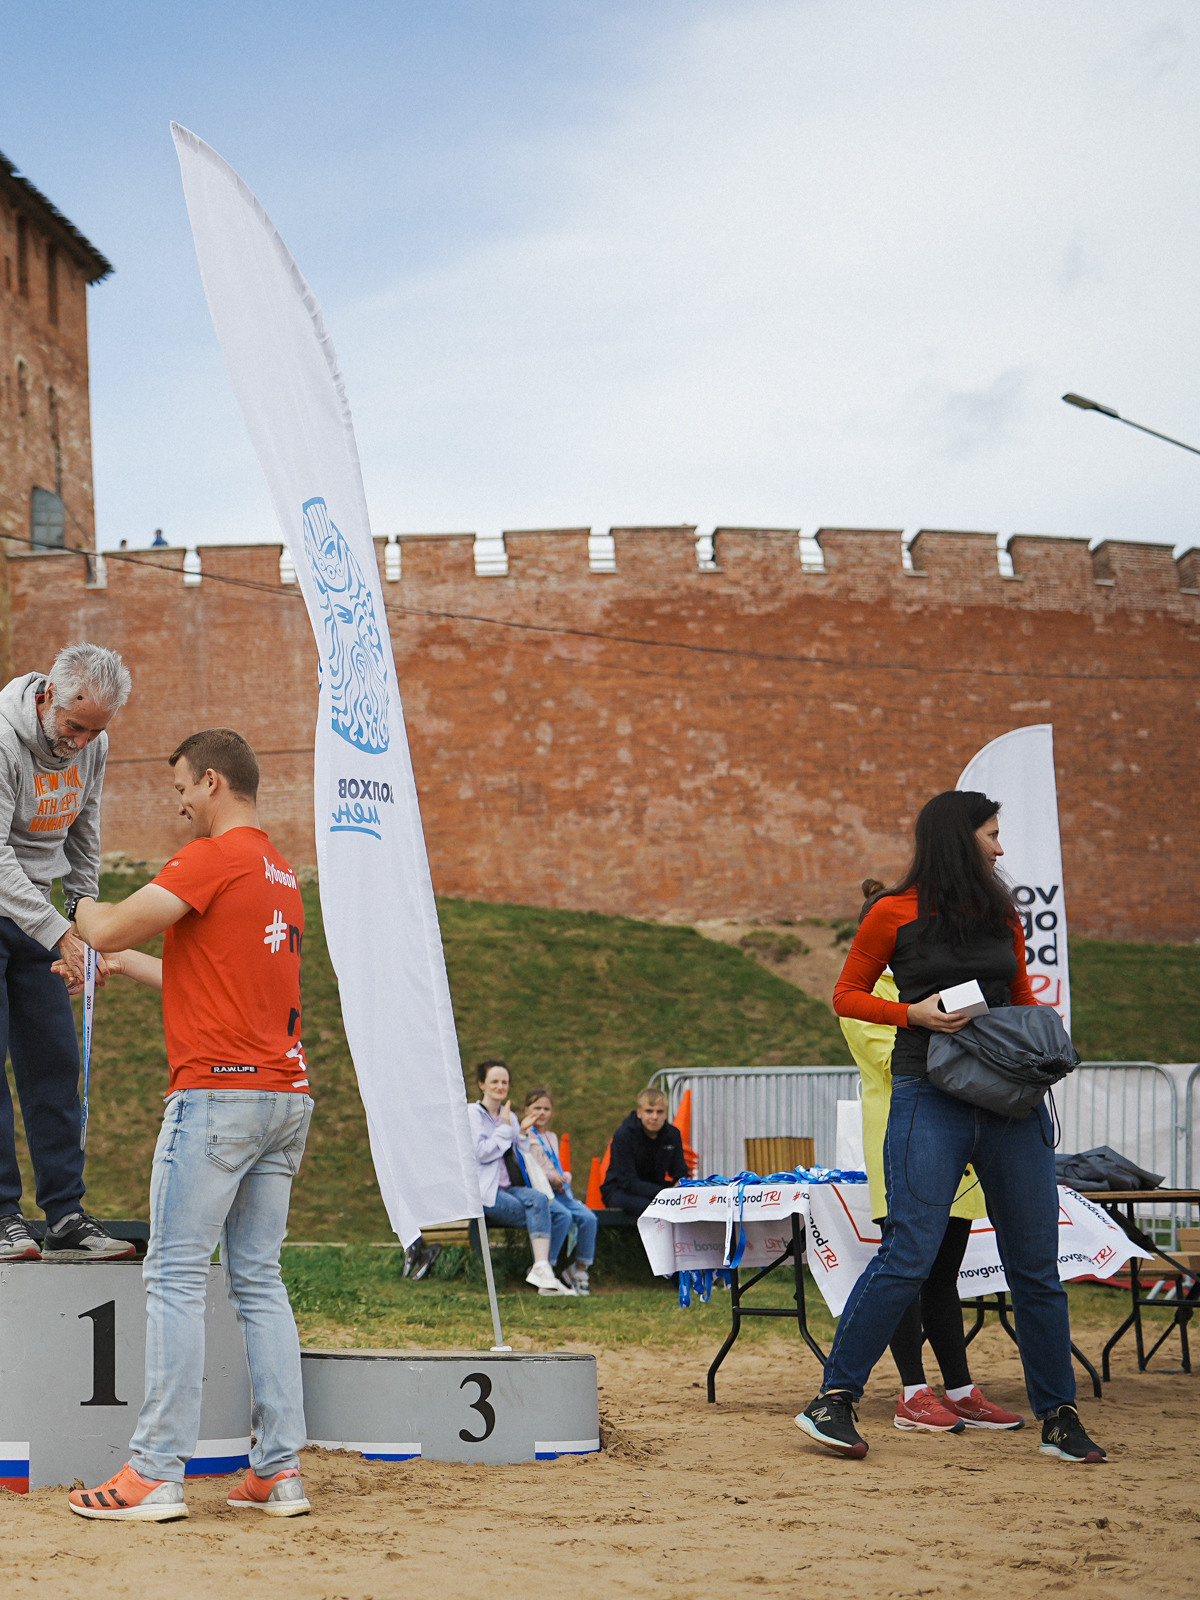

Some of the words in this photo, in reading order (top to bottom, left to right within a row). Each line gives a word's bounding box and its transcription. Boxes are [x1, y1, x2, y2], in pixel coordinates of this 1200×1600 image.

[33, 772, 59, 798] NEW
[1012, 885, 1059, 905] ov
[264, 909, 304, 957] #n
[650, 1194, 698, 1207] gorodTRI
[709, 1190, 782, 1207] #nogorodTRI
[959, 1265, 1005, 1279] novgoro
[78, 1300, 127, 1406] 1
[459, 1372, 495, 1442] 3
